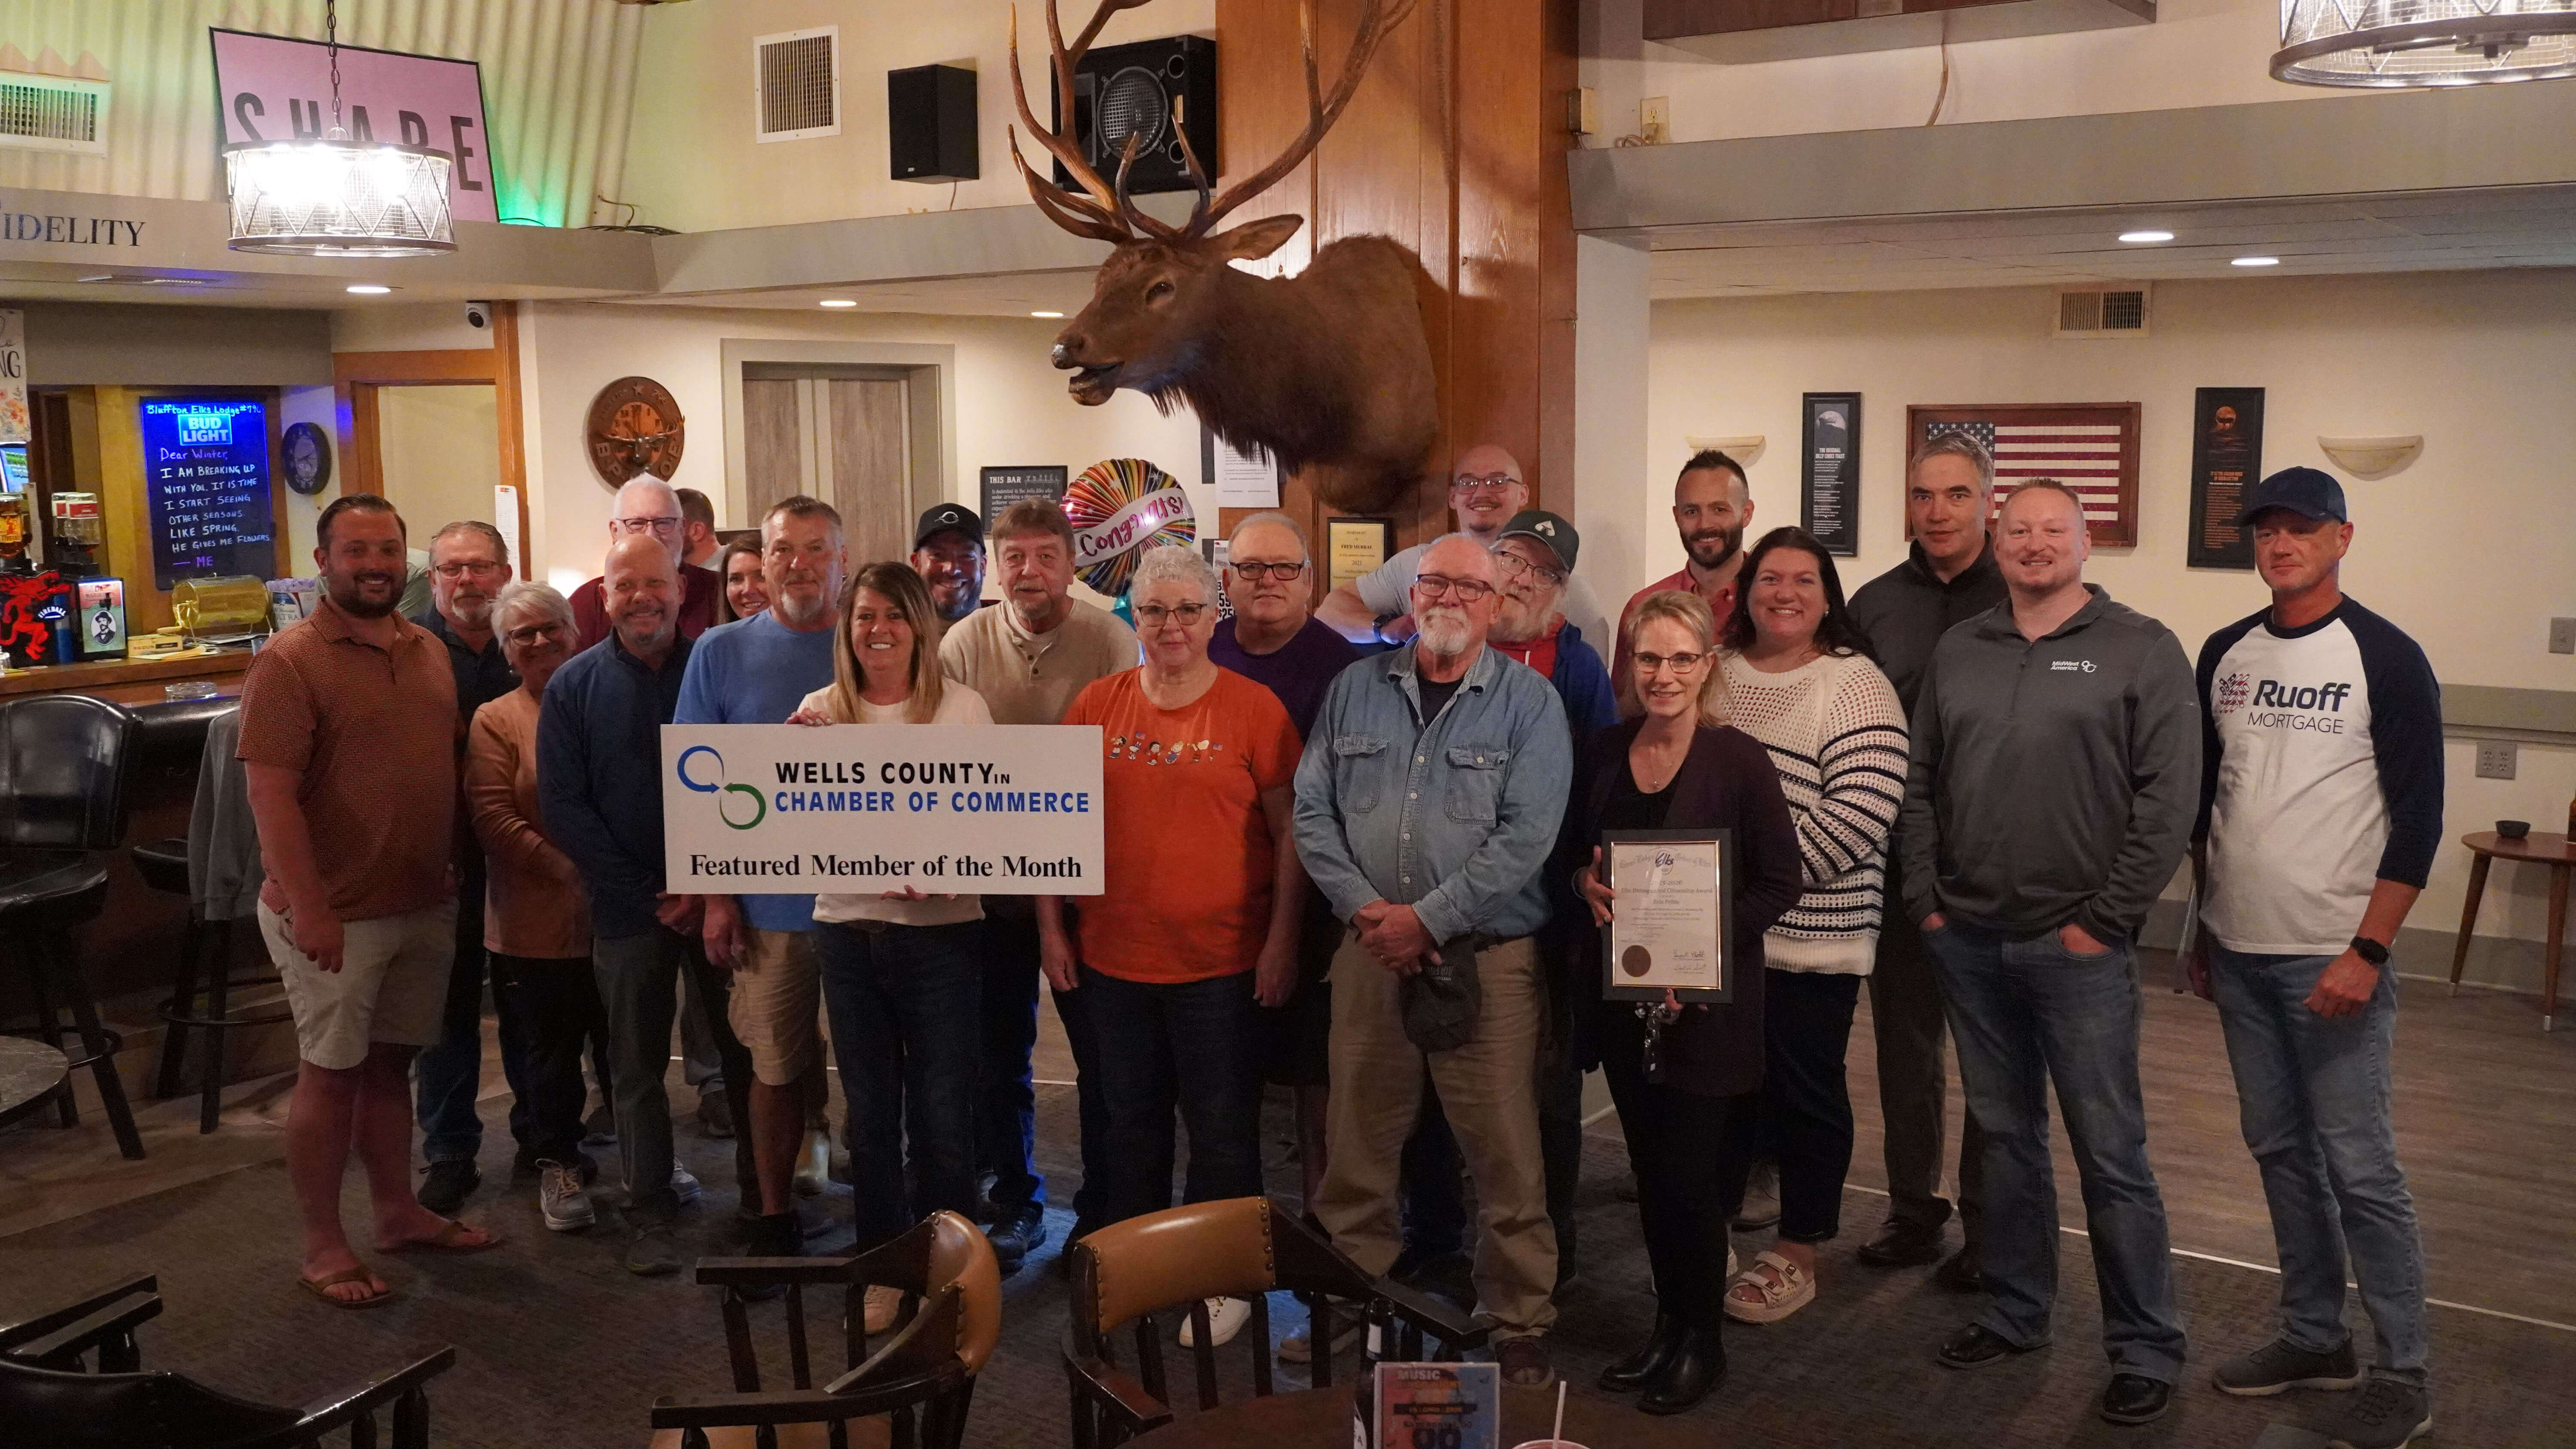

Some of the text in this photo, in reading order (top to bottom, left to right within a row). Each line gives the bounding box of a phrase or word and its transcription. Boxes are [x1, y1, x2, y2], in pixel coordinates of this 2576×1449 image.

[0, 200, 146, 246] IDELITY
[146, 404, 188, 414] Bluffton
[191, 405, 211, 414] Elks
[188, 417, 222, 429] BUD
[183, 430, 228, 442] LIGHT
[161, 448, 188, 461] Dear
[160, 464, 255, 479] I AM BREAKING UP
[164, 485, 186, 494] WITH
[211, 481, 225, 490] IT
[228, 480, 236, 488] IS
[238, 478, 257, 487] TIME
[164, 494, 251, 510] I START SEEING
[169, 515, 199, 524] OTHER
[170, 528, 195, 538] LIKE
[172, 543, 187, 553] HE
[192, 540, 216, 549] GIVES
[196, 556, 213, 567] ME
[2253, 679, 2351, 712] Ruoff
[2248, 712, 2344, 734] MORTGAGE
[775, 762, 1010, 784] WELLS COUNTY IN
[775, 791, 1089, 812] CHAMBER OF COMMERCE
[690, 855, 1082, 878] Featured Member of the Month
[1397, 1370, 1441, 1380] MUSIC
